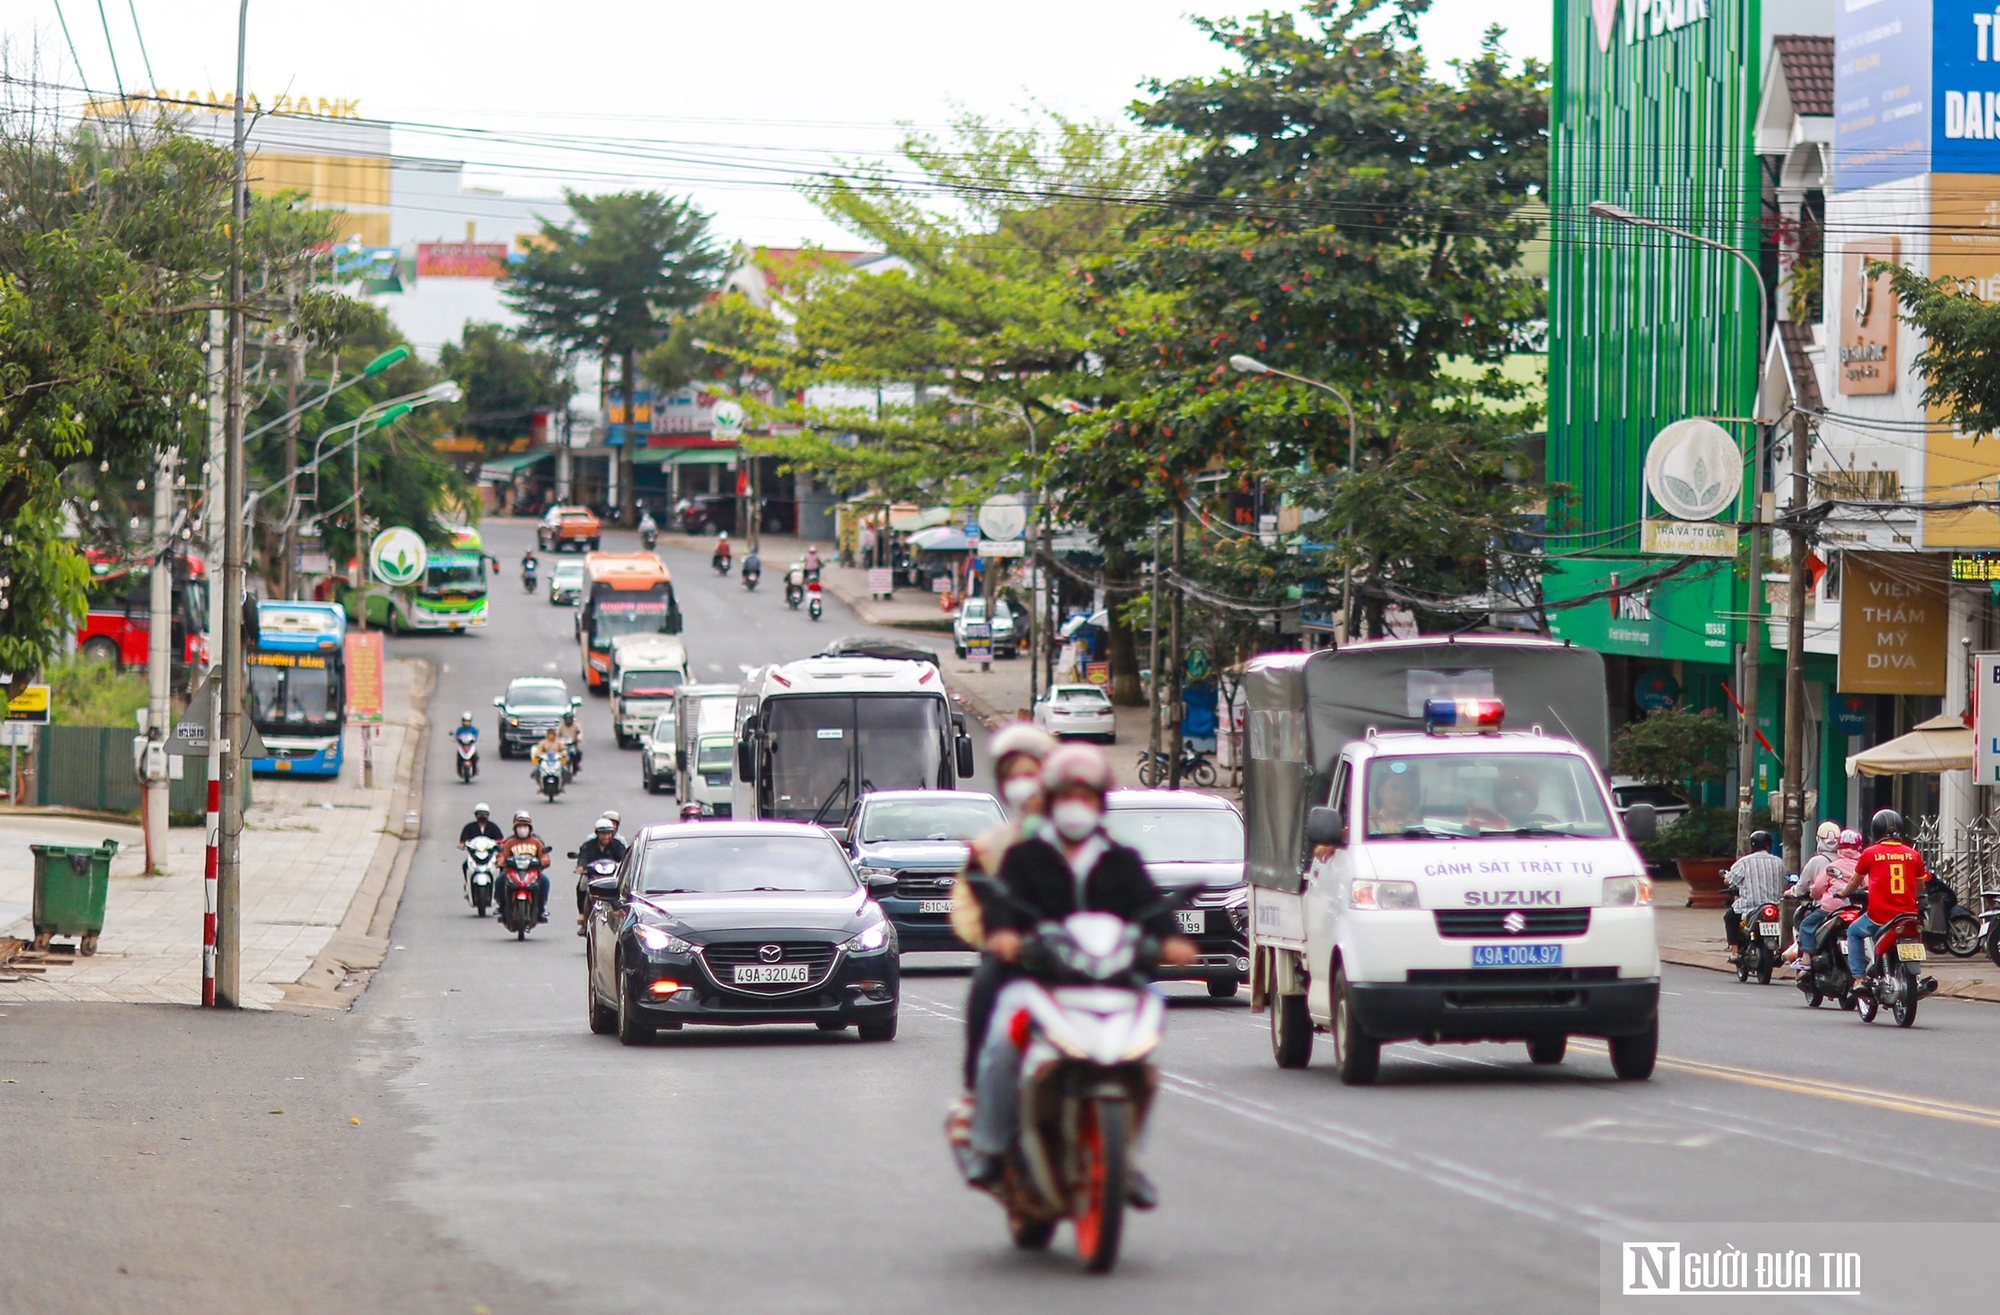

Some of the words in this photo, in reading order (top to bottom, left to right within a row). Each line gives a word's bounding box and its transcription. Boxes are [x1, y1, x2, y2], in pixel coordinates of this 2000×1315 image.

[1945, 91, 2000, 140] DAI
[1867, 581, 1922, 600] VIỆN
[1861, 602, 1926, 623] THẨM
[1867, 654, 1917, 669] DIVA
[1424, 860, 1473, 877] CẢNH
[1478, 858, 1511, 874] SÁT
[1518, 858, 1563, 876] TRẬT
[1890, 863, 1905, 894] 8
[1463, 890, 1562, 907] SUZUKI
[1474, 946, 1560, 965] 49A-004.97
[737, 967, 807, 982] 49A-320.46
